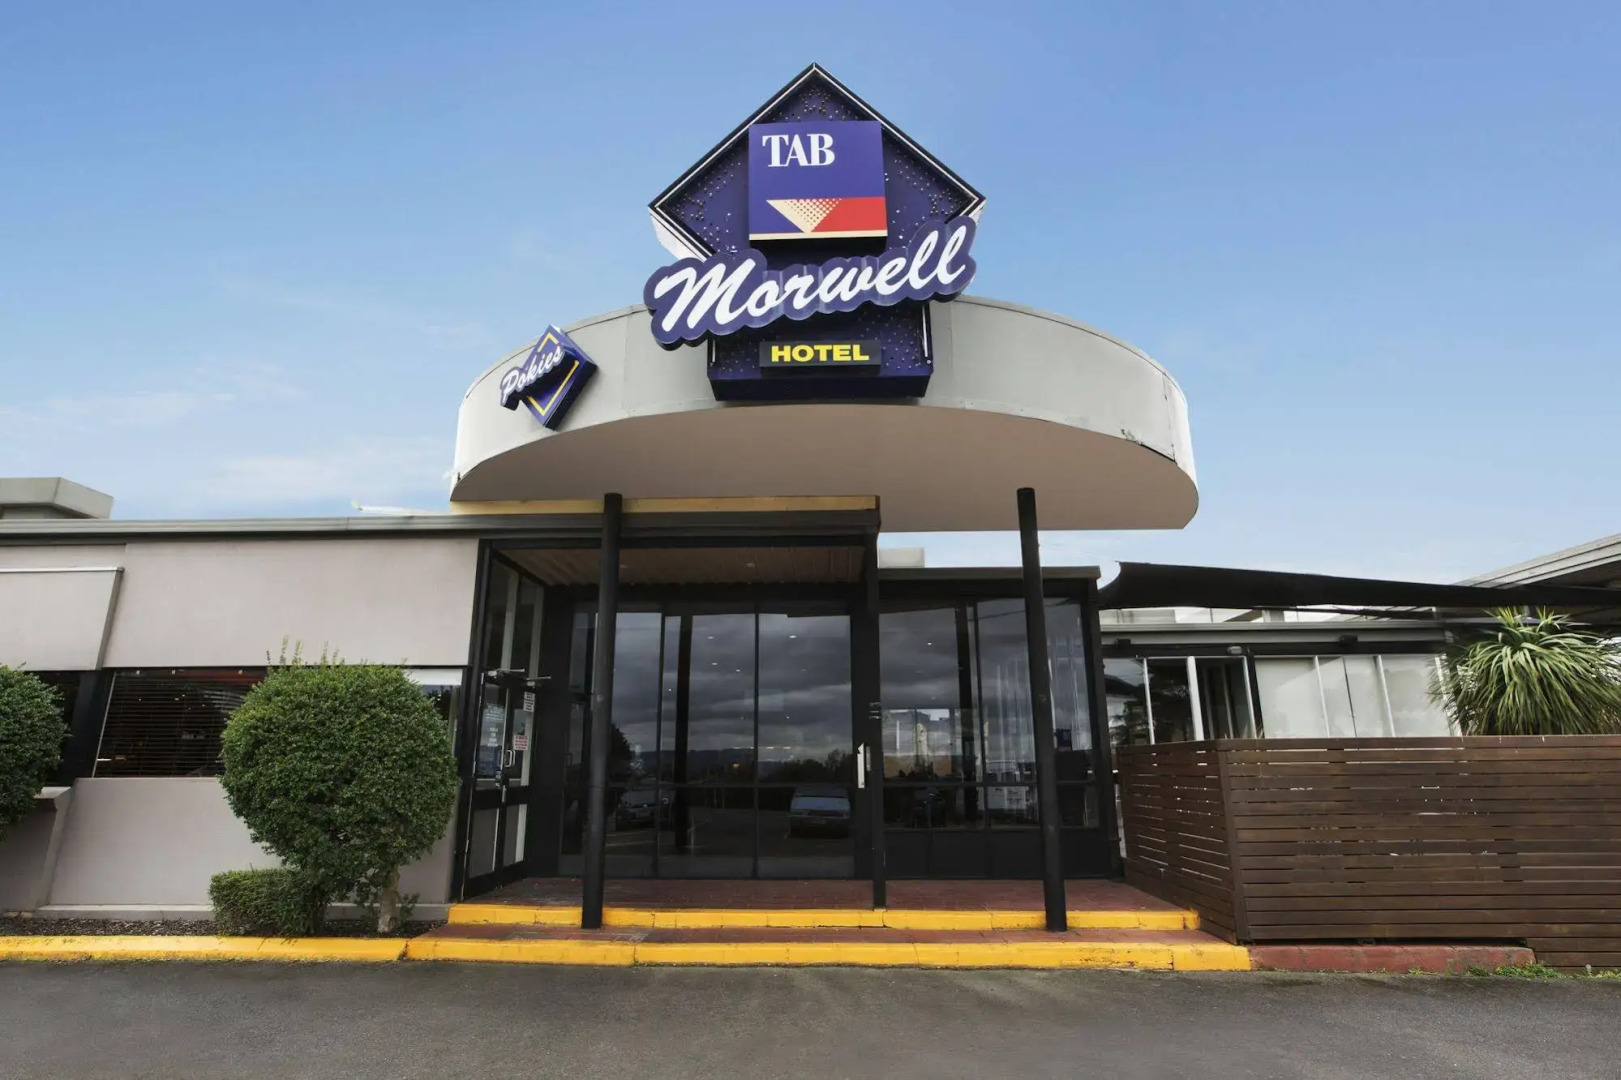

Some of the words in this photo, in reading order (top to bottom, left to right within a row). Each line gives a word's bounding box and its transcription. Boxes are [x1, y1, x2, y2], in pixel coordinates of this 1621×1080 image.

[762, 133, 835, 167] TAB
[654, 225, 967, 332] Morwell
[502, 345, 563, 404] Pokies
[771, 344, 870, 362] HOTEL
